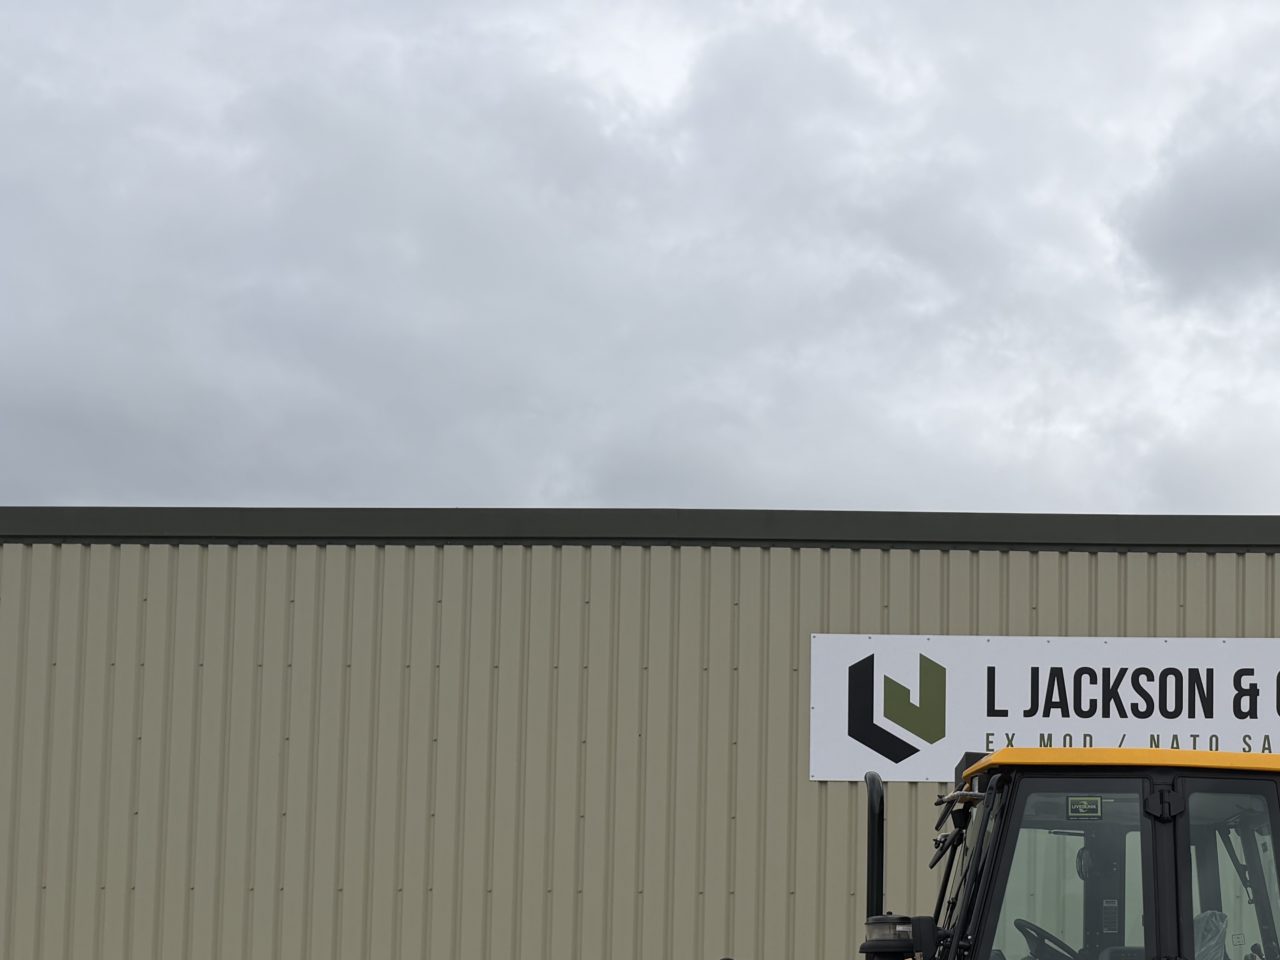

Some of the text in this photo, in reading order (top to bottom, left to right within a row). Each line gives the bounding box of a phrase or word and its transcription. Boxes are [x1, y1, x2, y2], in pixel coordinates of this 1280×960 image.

[986, 666, 1008, 717] L
[1023, 667, 1214, 719] JACKSON
[1232, 668, 1260, 719] &
[986, 733, 1016, 752] EX
[1039, 733, 1093, 748] MOD
[1150, 734, 1219, 751] NATO
